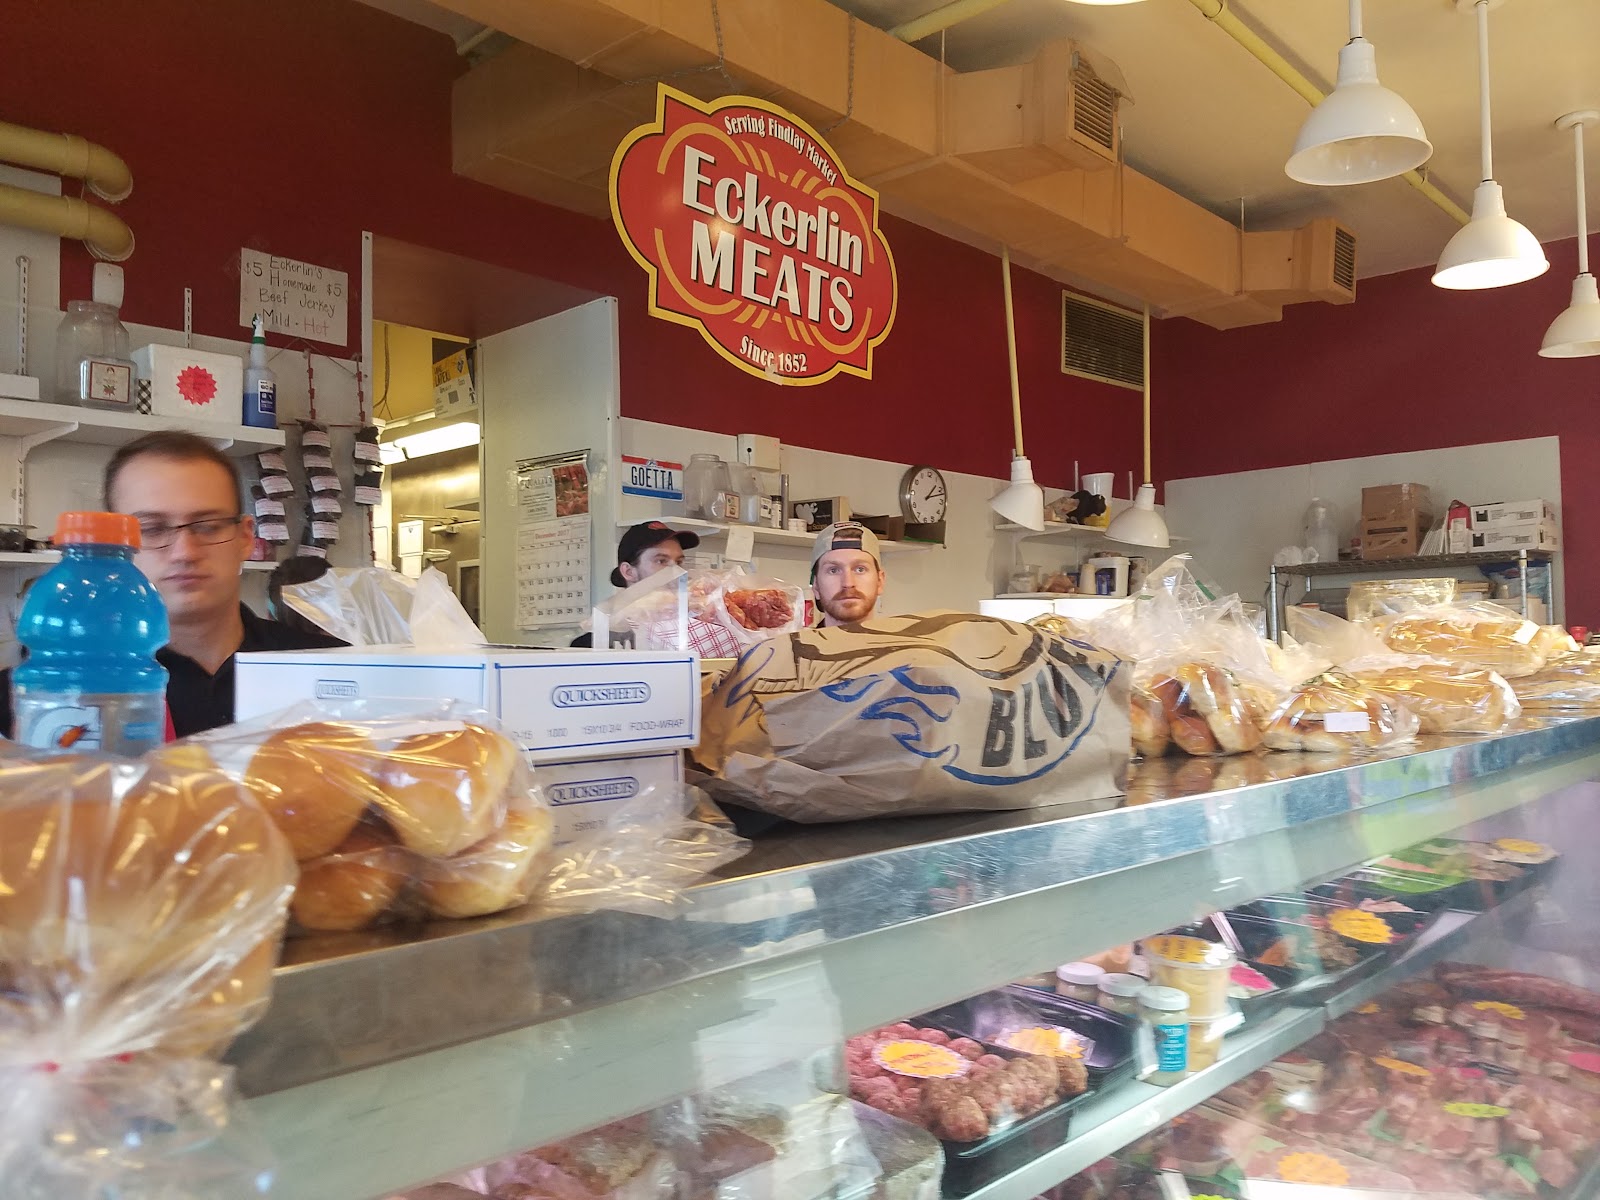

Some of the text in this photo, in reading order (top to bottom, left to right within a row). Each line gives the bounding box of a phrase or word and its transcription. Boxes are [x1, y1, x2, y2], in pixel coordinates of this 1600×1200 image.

[724, 115, 838, 186] Serving Findlay Market
[682, 145, 864, 276] Eckerlin
[244, 262, 263, 277] $5
[690, 220, 855, 333] MEATS
[270, 270, 318, 294] Homemade
[326, 283, 342, 298] $5
[259, 287, 289, 305] Beef
[262, 308, 329, 337] Mild Hot
[739, 335, 808, 373] Since 1852
[631, 465, 674, 491] GOETTA
[557, 685, 648, 705] QUICKSHEETS
[629, 718, 685, 731] FOOD-WRAP
[551, 780, 636, 804] QUICKSHEETS
